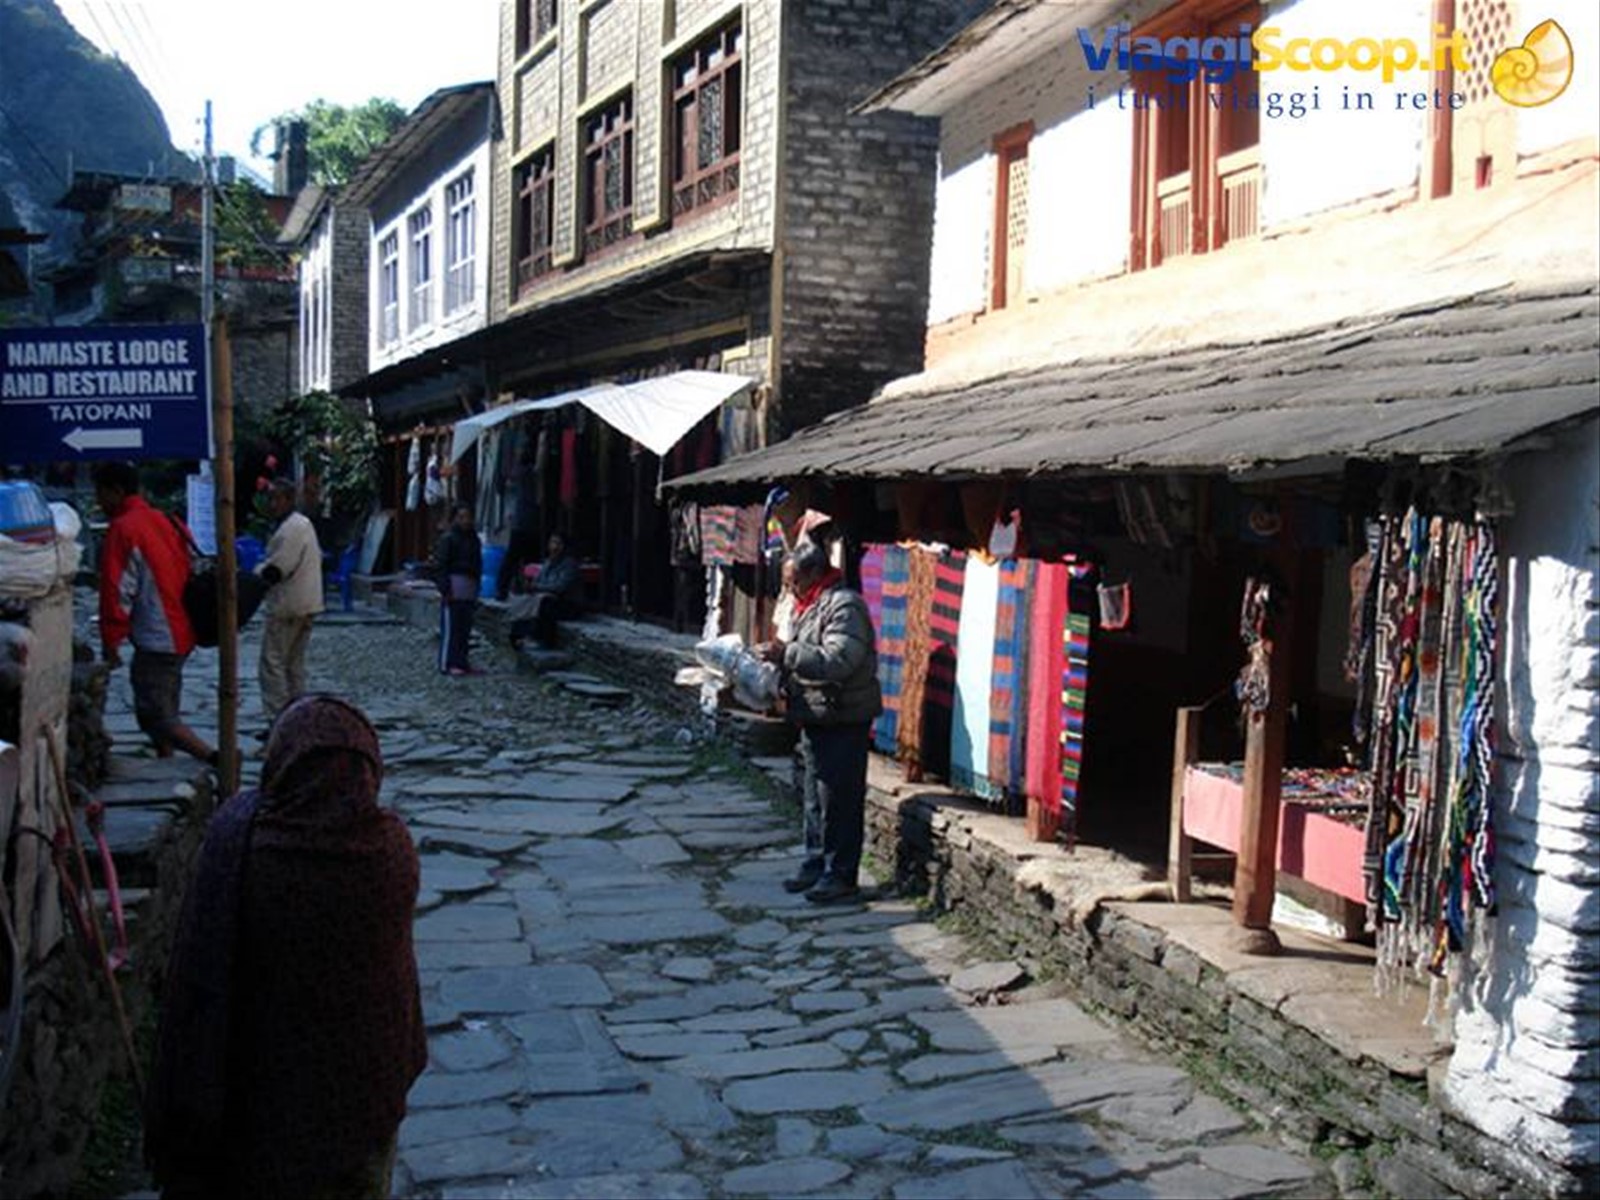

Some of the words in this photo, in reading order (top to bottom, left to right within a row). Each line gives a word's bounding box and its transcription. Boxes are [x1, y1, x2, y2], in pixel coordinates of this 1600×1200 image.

[8, 341, 114, 367] NAMASTE
[119, 339, 189, 365] LODGE
[2, 372, 48, 398] AND
[53, 369, 197, 396] RESTAURANT
[49, 403, 151, 422] TATOPANI
